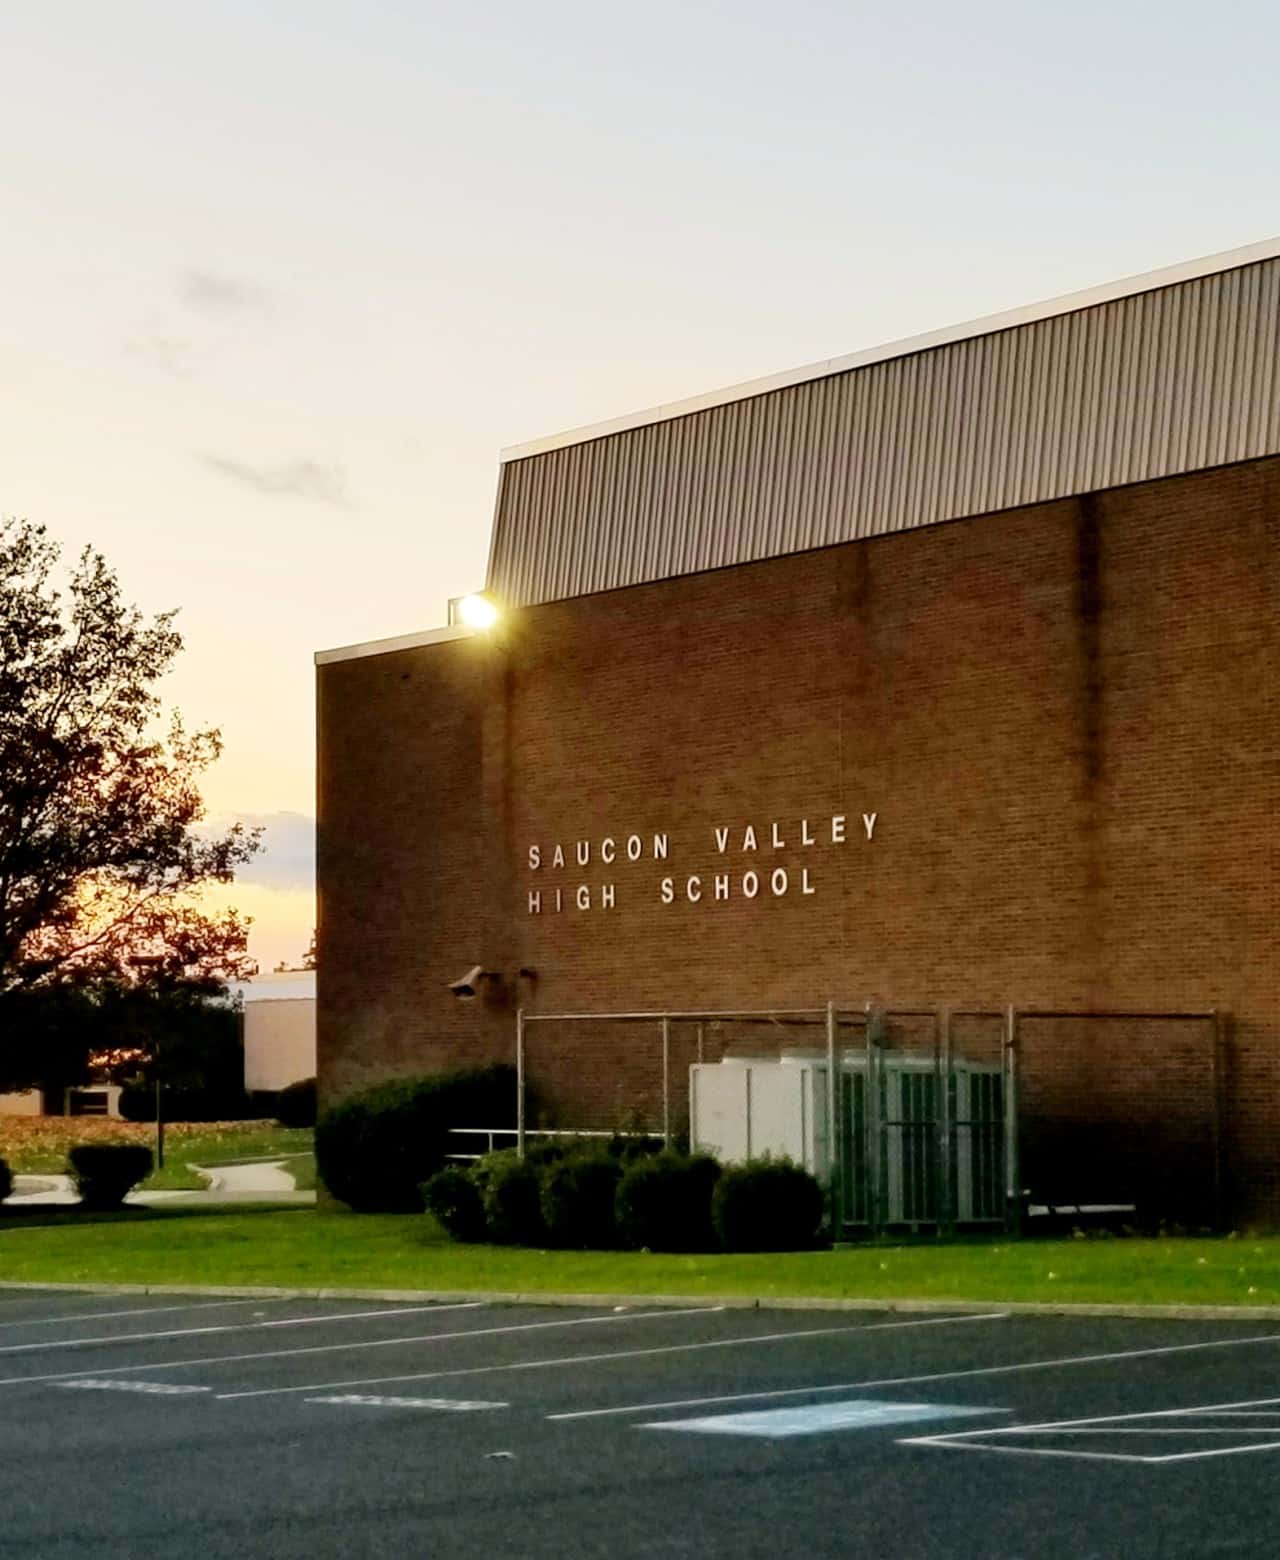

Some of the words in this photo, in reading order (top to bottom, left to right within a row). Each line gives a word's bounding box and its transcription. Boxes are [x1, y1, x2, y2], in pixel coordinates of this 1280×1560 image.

[528, 833, 668, 870] SAUCON
[715, 812, 878, 854] VALLEY
[528, 884, 616, 913] HIGH
[660, 868, 816, 903] SCHOOL
